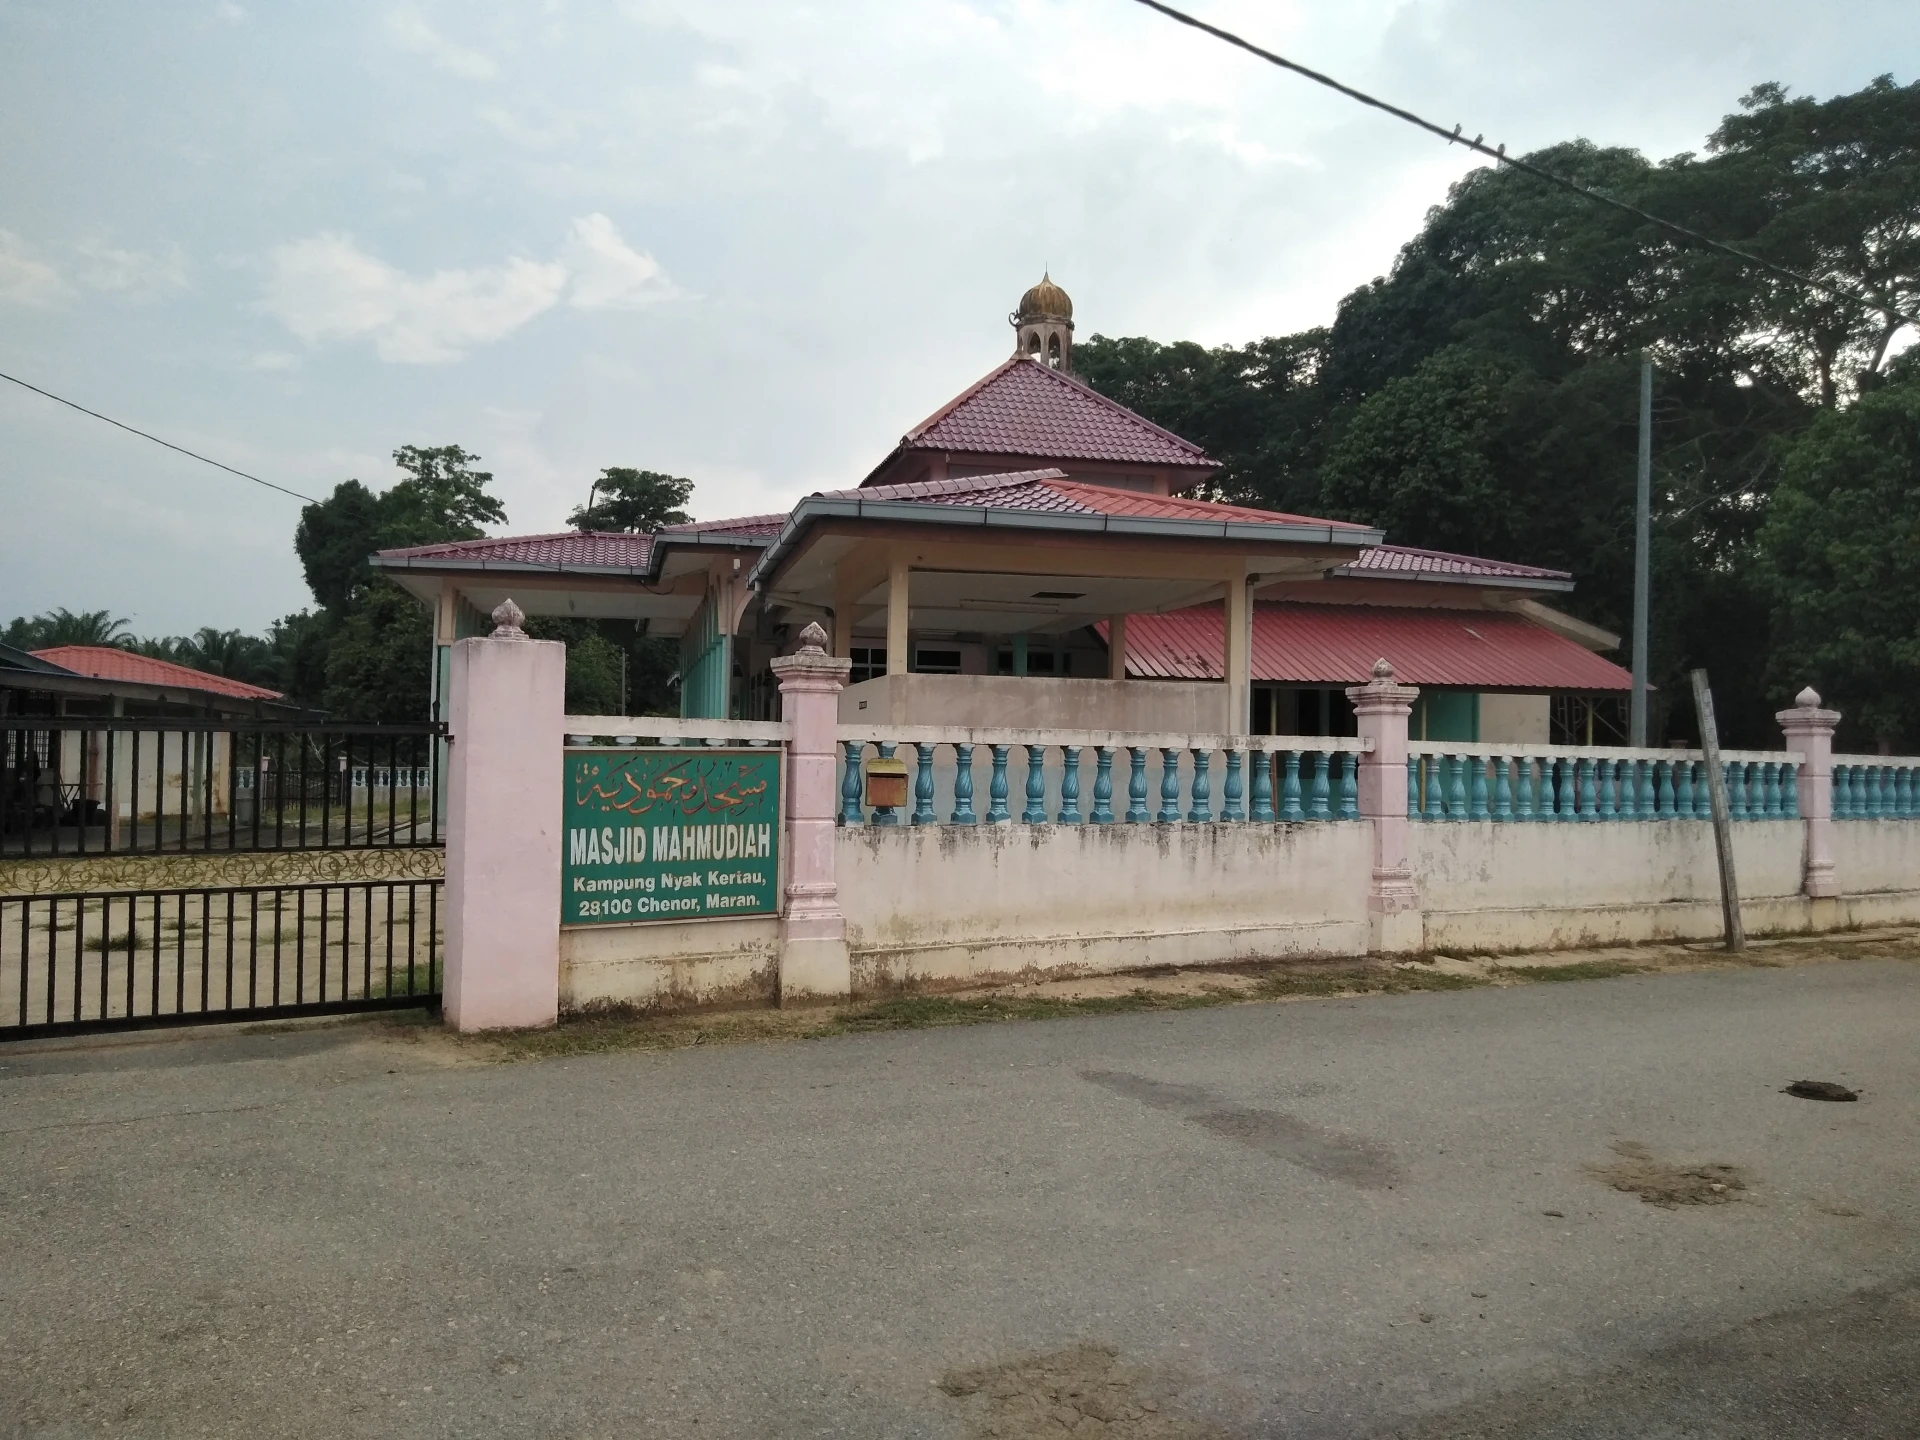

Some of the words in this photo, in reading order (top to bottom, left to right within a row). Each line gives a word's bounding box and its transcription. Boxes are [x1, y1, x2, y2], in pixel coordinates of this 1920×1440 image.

[570, 827, 646, 865] MASJID
[653, 823, 770, 861] MAHMUDIAH
[573, 877, 655, 893] Kampung
[661, 873, 702, 891] Nyak
[708, 871, 766, 886] Kertau,
[579, 899, 631, 916] 28100
[638, 897, 700, 912] Chenor,
[706, 893, 760, 908] Maran.
